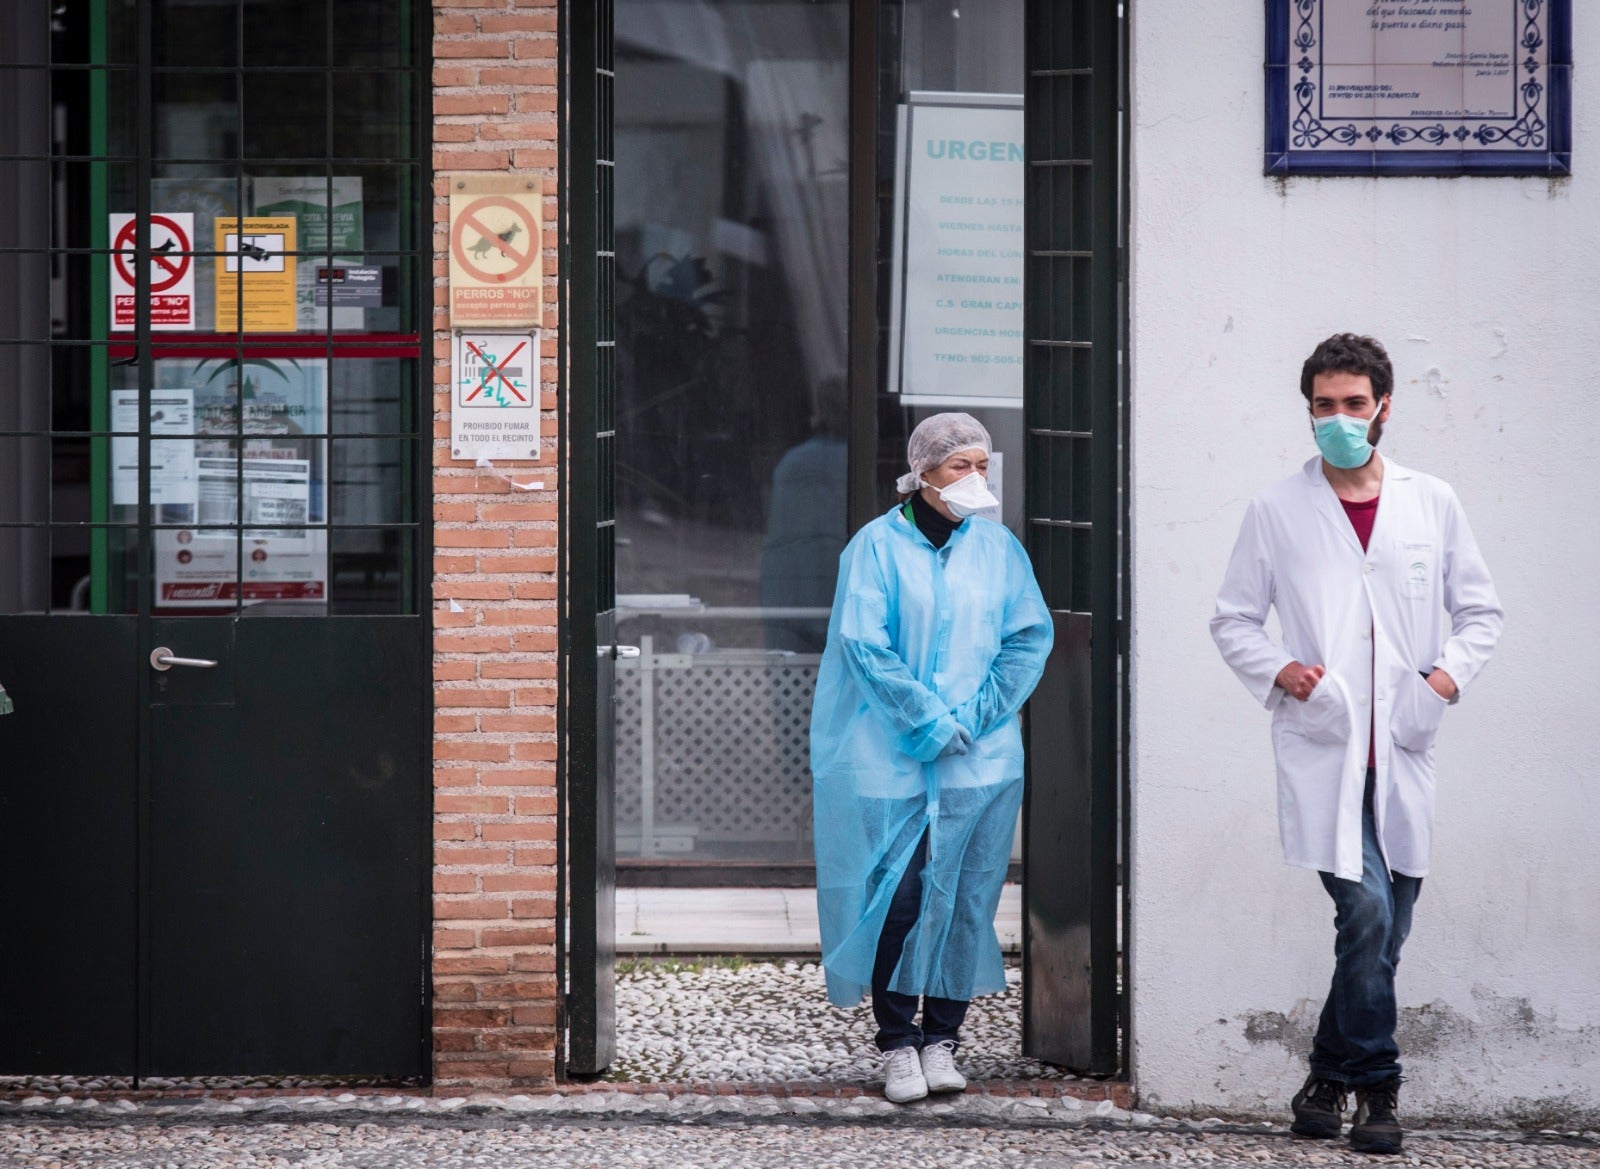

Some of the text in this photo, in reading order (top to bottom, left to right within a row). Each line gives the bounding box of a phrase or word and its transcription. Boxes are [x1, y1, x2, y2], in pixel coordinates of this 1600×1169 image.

[926, 139, 1024, 162] URGEN
[456, 288, 504, 299] PERROS
[456, 302, 488, 310] excepto
[489, 302, 516, 310] perros
[935, 327, 995, 337] URGENCIAS
[463, 422, 530, 430] PROHIBIDO FUMAR
[459, 434, 534, 442] EN TODO EL RECINTO
